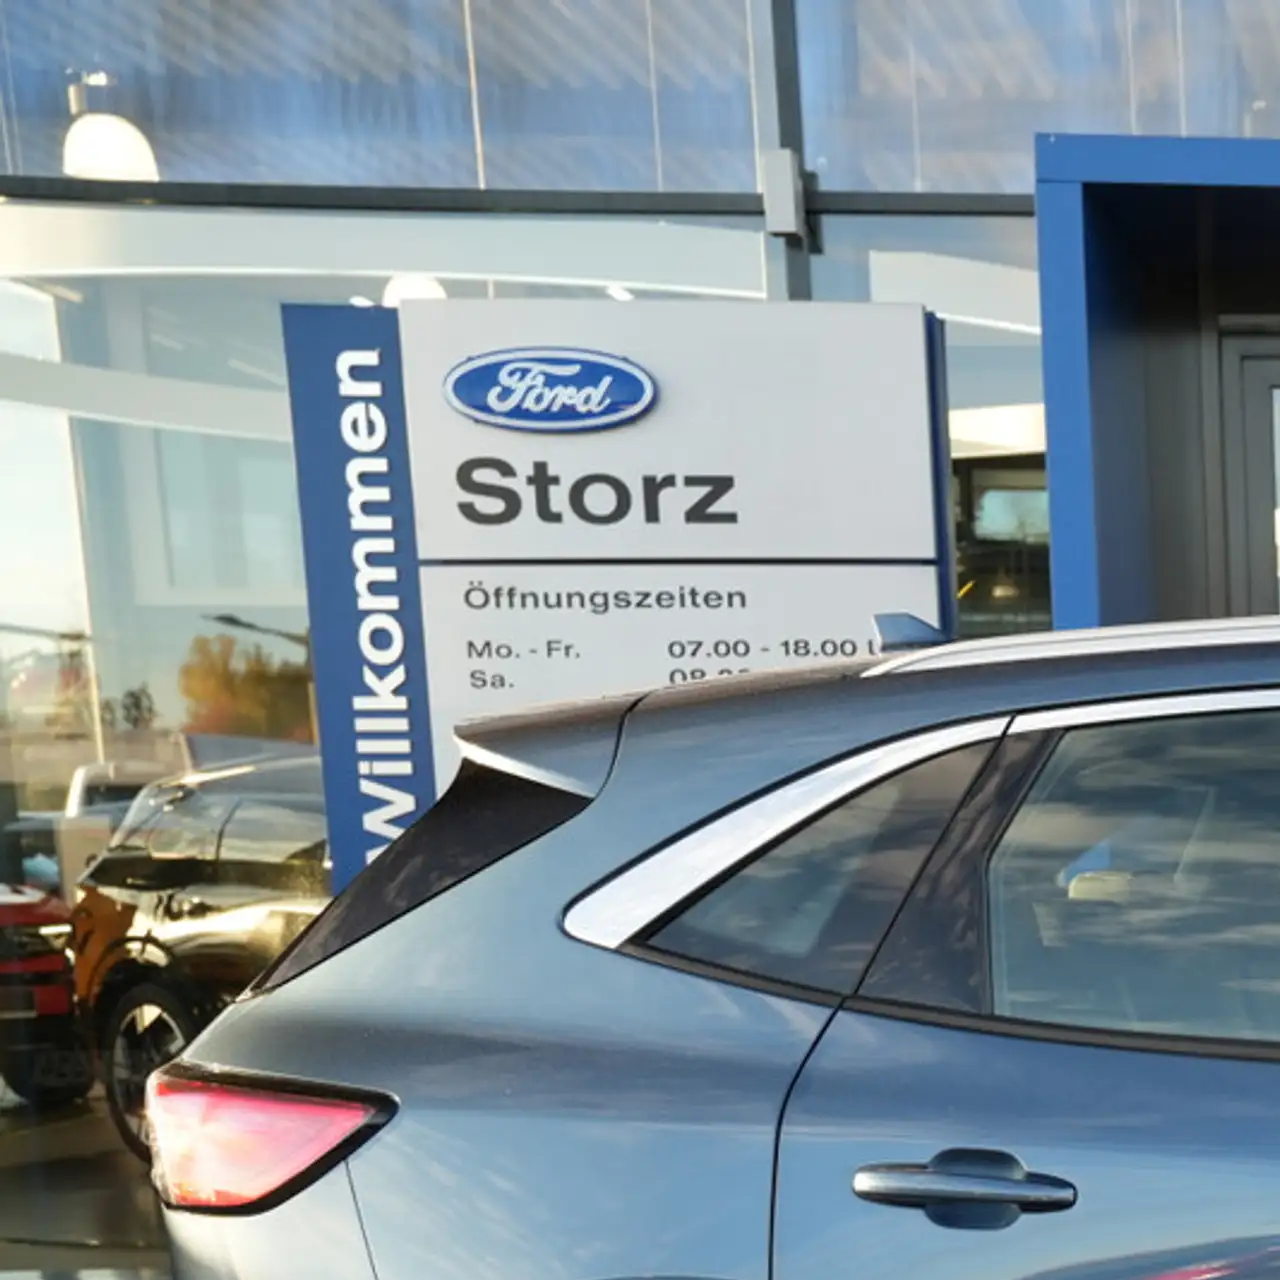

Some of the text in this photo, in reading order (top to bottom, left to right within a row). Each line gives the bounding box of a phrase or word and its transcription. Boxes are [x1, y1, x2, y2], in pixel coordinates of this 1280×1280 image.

[486, 361, 613, 413] Ford
[455, 456, 738, 525] Storz
[335, 347, 417, 866] Willkommen
[463, 580, 748, 615] Öffnungszeiten
[466, 640, 520, 659] Mo.
[546, 639, 581, 660] Fr.
[667, 640, 751, 659] 07.00
[779, 638, 857, 658] 18.00
[469, 669, 515, 689] Sa.
